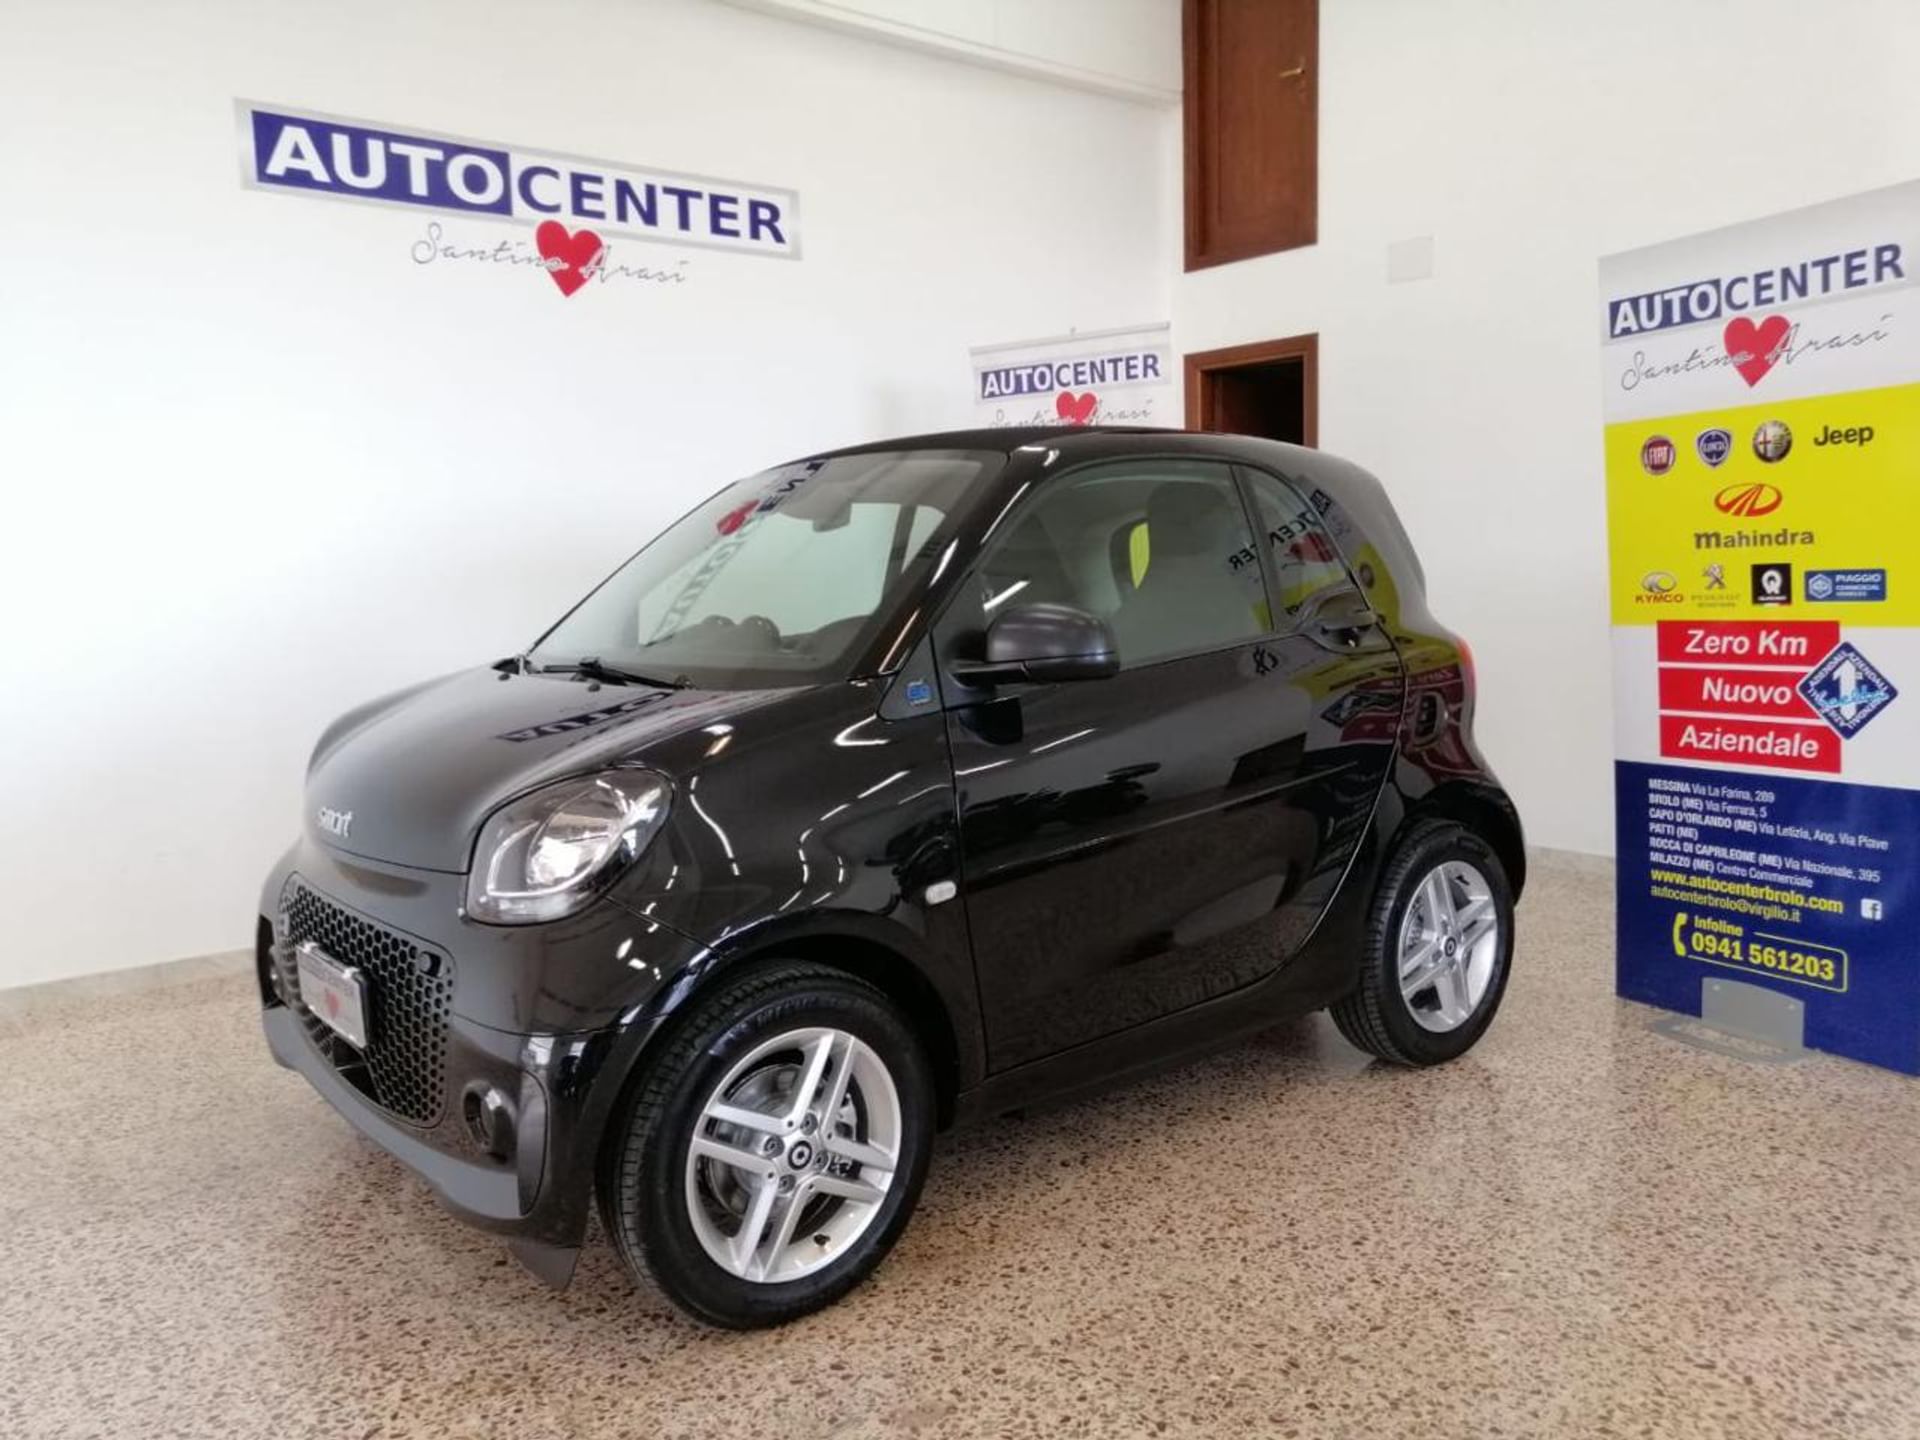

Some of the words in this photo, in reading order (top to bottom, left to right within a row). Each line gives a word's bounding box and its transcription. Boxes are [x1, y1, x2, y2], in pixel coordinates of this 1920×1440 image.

[411, 222, 569, 272] Santino
[579, 244, 689, 284] Arasi
[1621, 345, 1754, 390] Santino
[1765, 314, 1894, 365] Arasi
[1813, 425, 1874, 447] Jeep
[1694, 528, 1815, 550] mahindra
[1635, 592, 1684, 604] KYMCO
[1684, 629, 1750, 655] Zero
[1757, 629, 1809, 657] Km
[1702, 677, 1792, 705] Nuovo
[1678, 724, 1820, 759] Aziendale
[1648, 778, 1691, 793] MESSINA
[1692, 783, 1706, 795] Via
[1708, 785, 1720, 797] La
[1648, 793, 1679, 806] BROLO
[1682, 797, 1703, 812] (ME)
[1705, 800, 1720, 812] Via
[1760, 806, 1768, 818] 5
[1649, 808, 1674, 820] CAPO
[1675, 811, 1732, 829] D'ORLANDO
[1734, 818, 1757, 834] (ME)
[1759, 822, 1775, 835] Via
[1838, 833, 1856, 846] Via
[1858, 835, 1888, 850] Piave
[1649, 822, 1675, 836] PATTI
[1677, 826, 1698, 841] (ME)
[1649, 836, 1680, 851] ROCCA
[1683, 841, 1693, 853] DI
[1695, 843, 1757, 863] CAPRILEONE
[1759, 853, 1782, 869] (ME)
[1784, 857, 1800, 870] Via
[1858, 868, 1880, 883] 395
[1650, 851, 1690, 868] MILAZZO
[1693, 858, 1714, 873] (ME)
[1717, 862, 1747, 877] Centro
[1749, 867, 1814, 888] Commerciale
[1651, 870, 1844, 913] www.autocenterbrolo.com
[1651, 886, 1801, 923] autocenterbrolo@virgilio.it
[1694, 916, 1743, 936] Infoline
[1691, 932, 1743, 961] 0941
[1749, 943, 1834, 980] 561203
